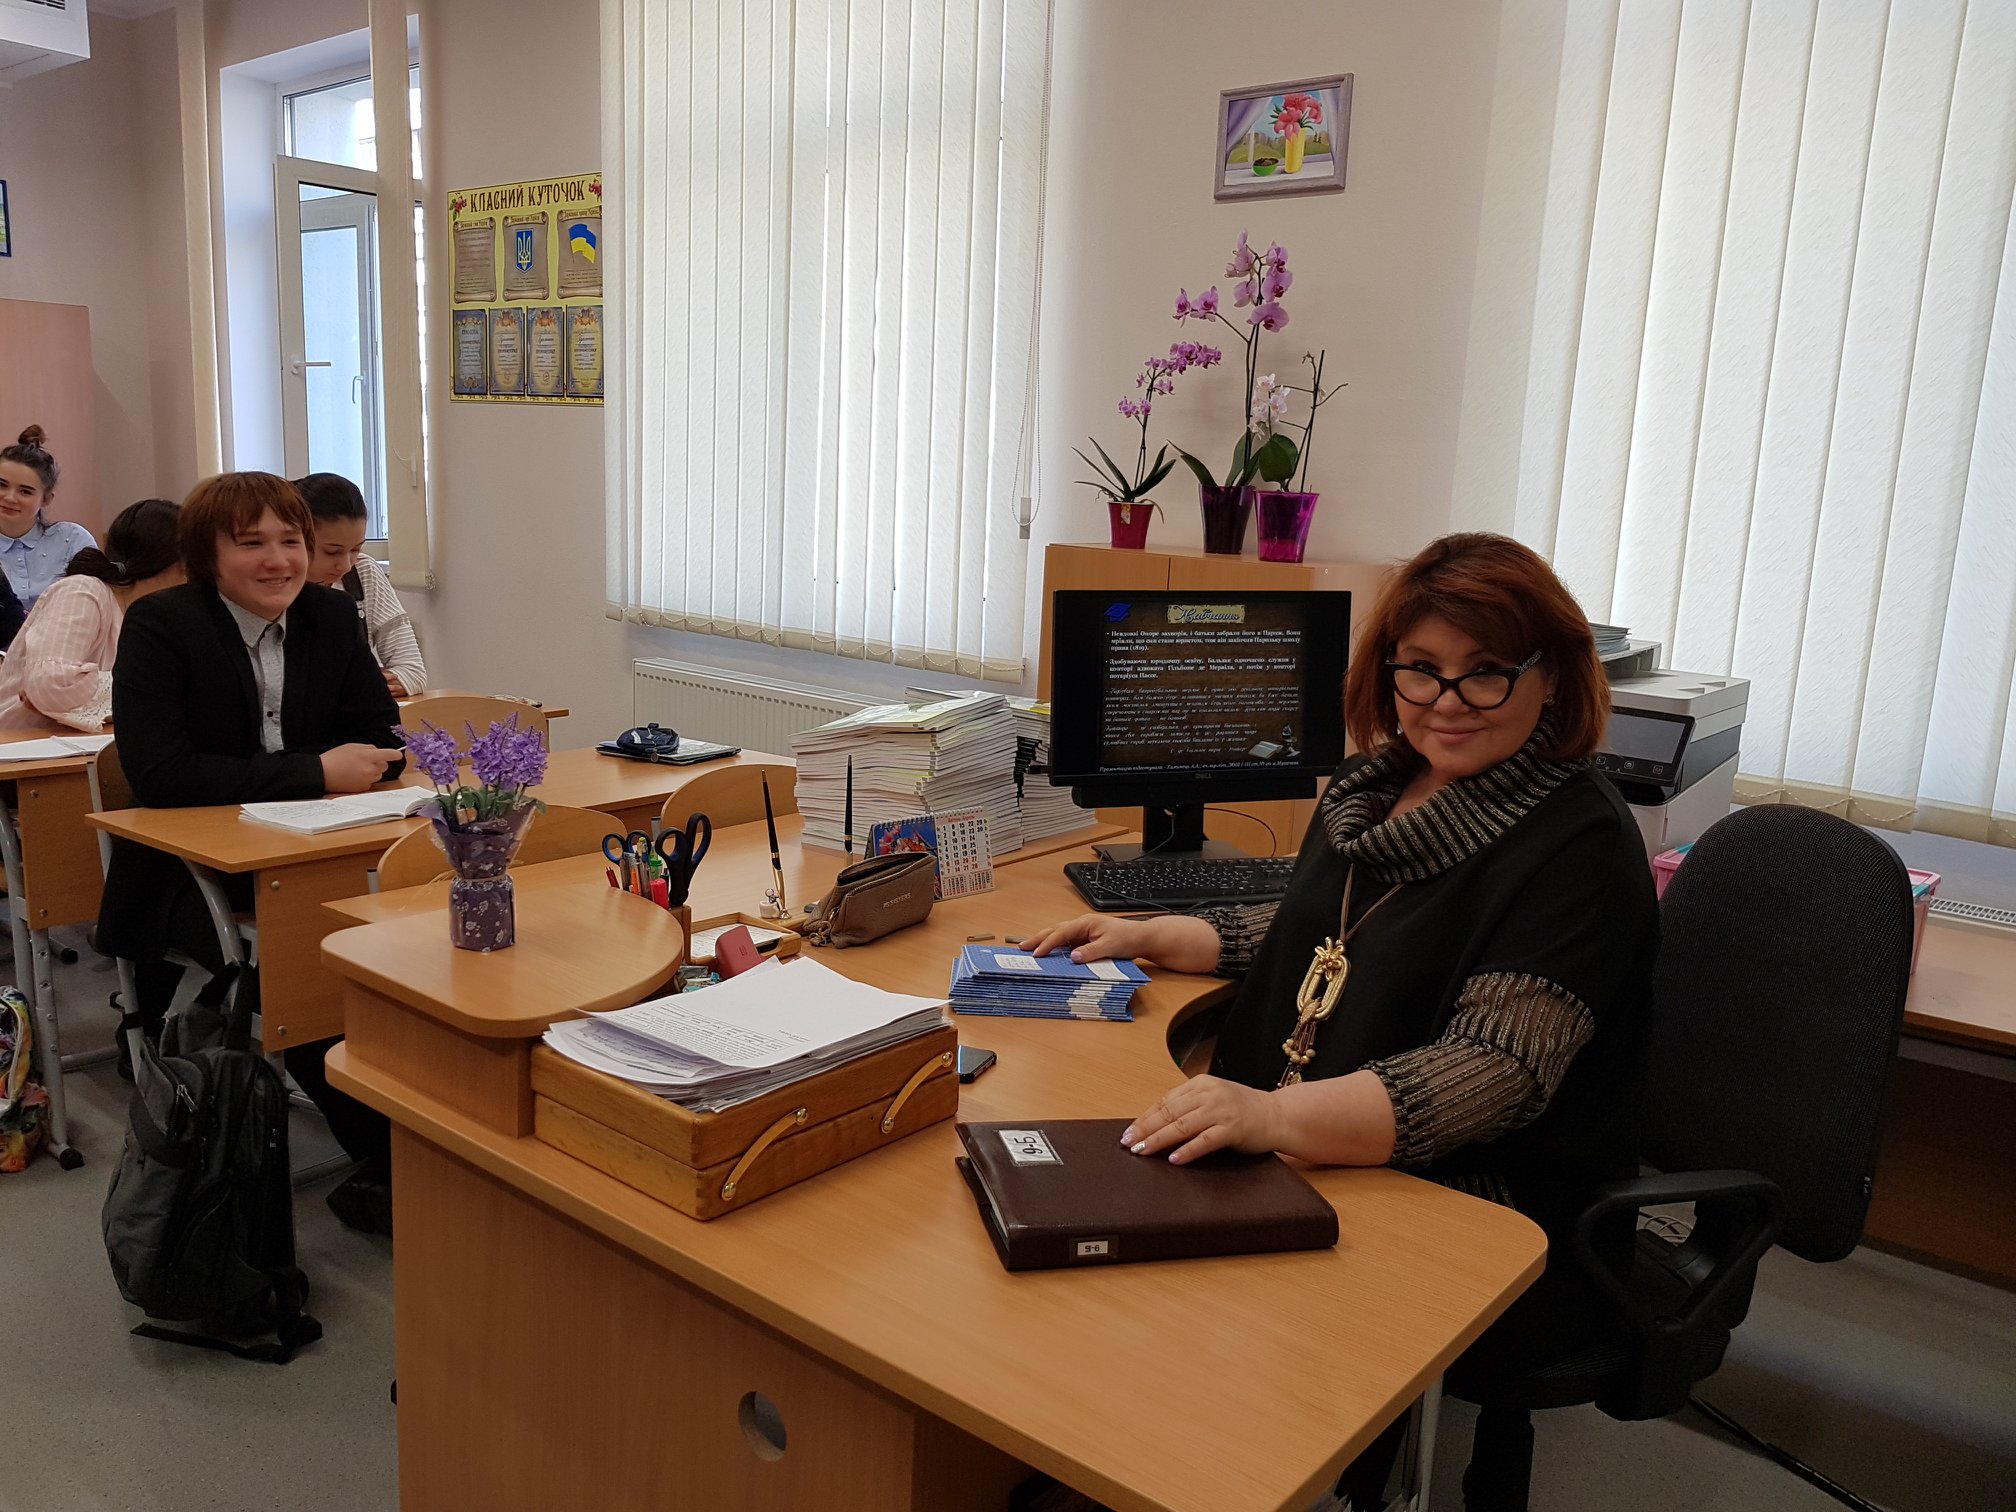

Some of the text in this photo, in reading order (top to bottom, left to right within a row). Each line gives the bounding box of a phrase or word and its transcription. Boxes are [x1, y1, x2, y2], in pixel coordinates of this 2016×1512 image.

[470, 180, 585, 212] КЛАСНИЙ КУТОЧОК
[1014, 1136, 1042, 1154] 9-Б
